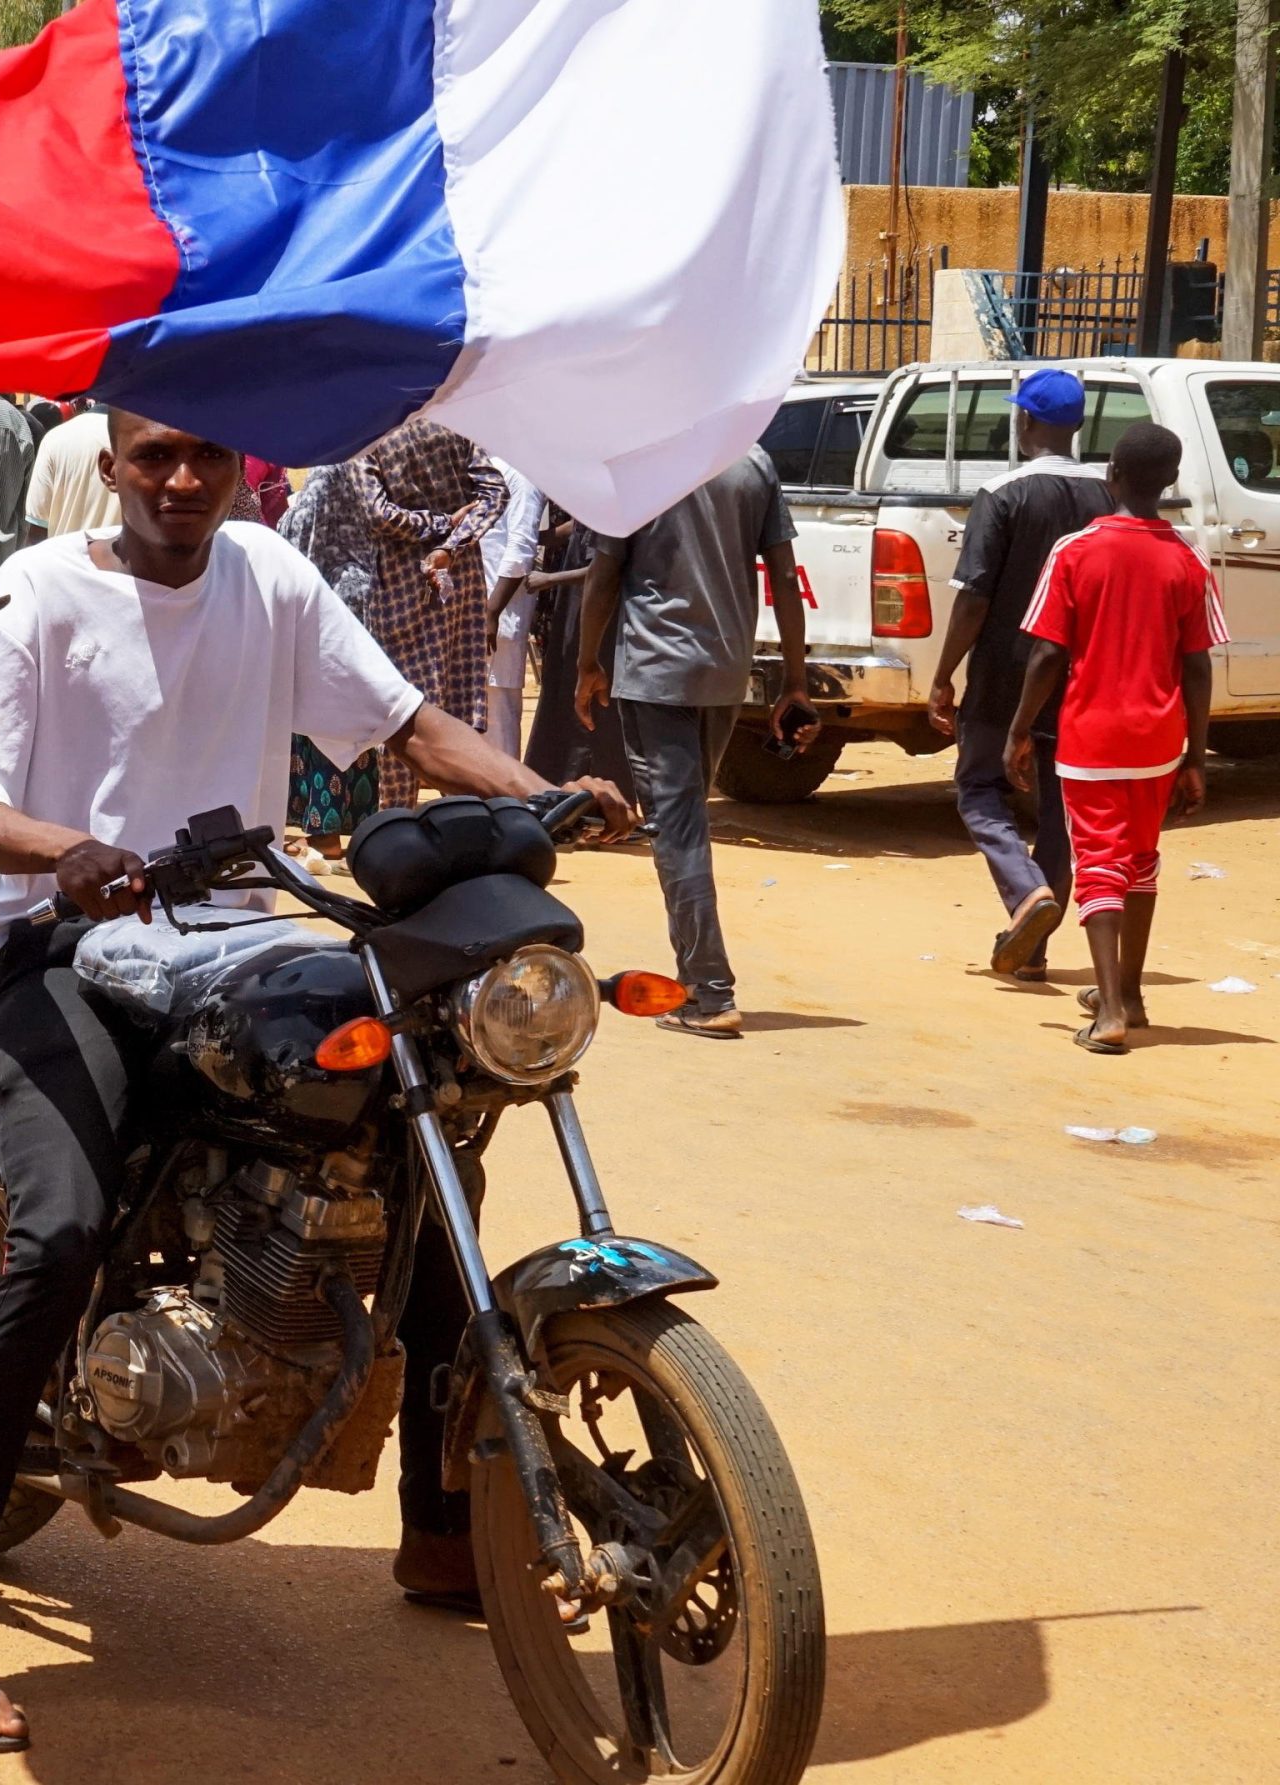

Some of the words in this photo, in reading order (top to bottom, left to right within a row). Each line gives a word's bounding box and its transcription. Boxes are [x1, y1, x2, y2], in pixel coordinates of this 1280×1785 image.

[947, 530, 965, 543] 2
[832, 544, 863, 554] DLX
[93, 1367, 135, 1390] APSONIC
